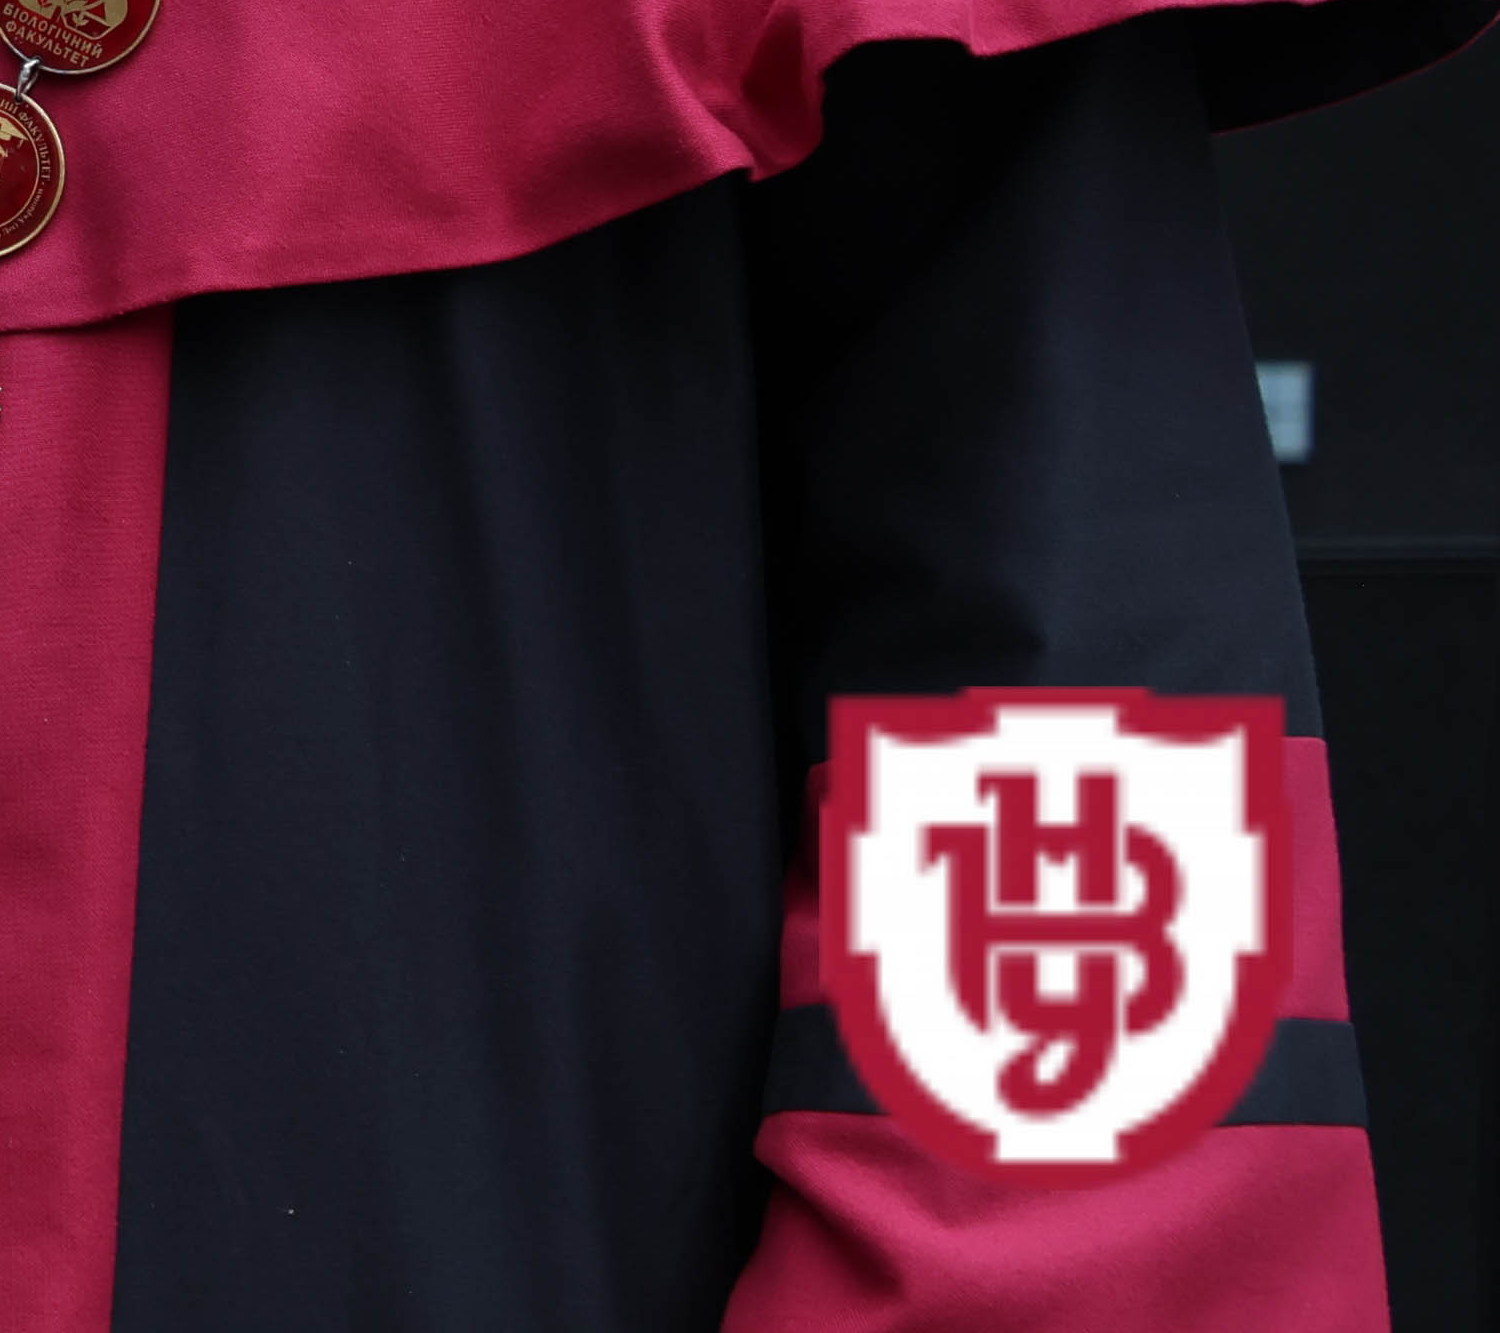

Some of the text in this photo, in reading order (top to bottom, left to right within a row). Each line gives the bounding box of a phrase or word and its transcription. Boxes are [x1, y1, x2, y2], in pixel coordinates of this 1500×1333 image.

[3, 2, 104, 59] БІОЛОГІЧНИЙ
[5, 20, 90, 68] ФАКУЛЬТЕТ
[18, 111, 52, 181] ФАКУЛЬТЕТ
